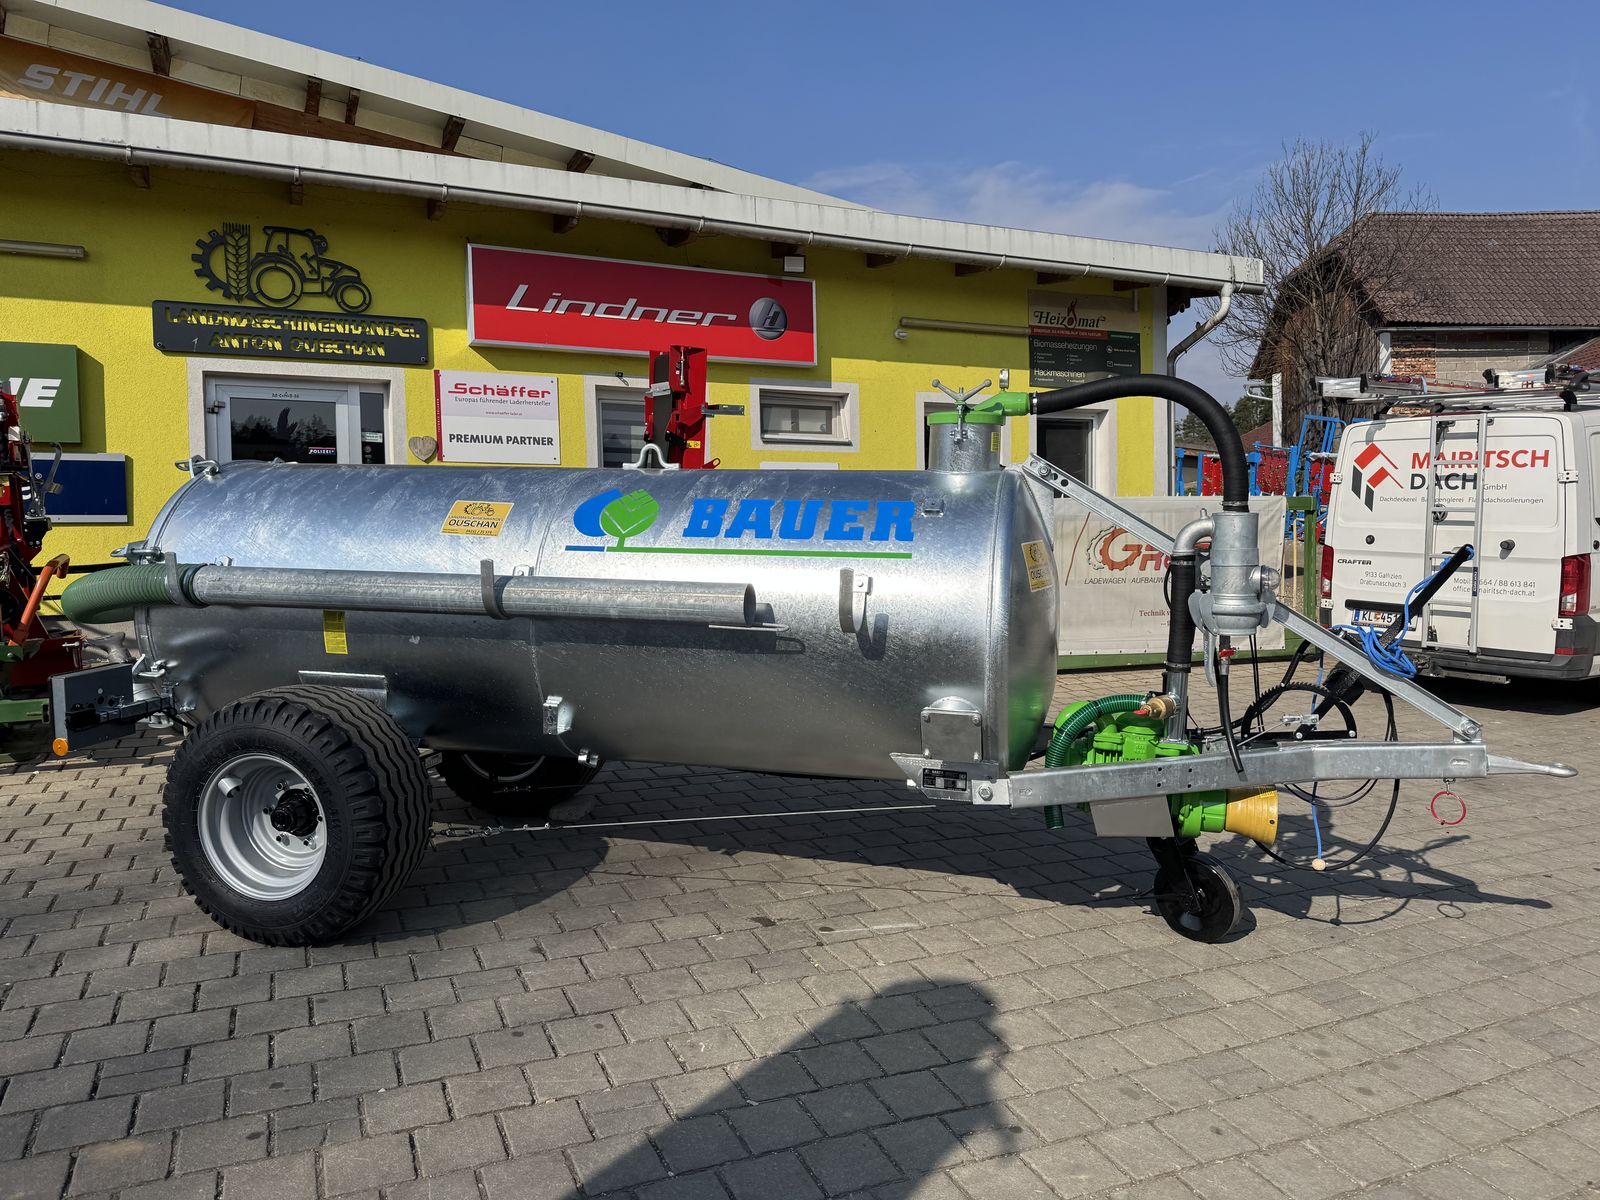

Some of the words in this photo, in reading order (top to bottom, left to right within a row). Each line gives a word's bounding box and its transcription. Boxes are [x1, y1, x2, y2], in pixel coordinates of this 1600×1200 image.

[17, 64, 174, 118] STIHL
[505, 284, 737, 326] Lindner
[164, 306, 421, 338] LANDMASCHINENHANDEL
[209, 332, 283, 351] ANTON
[290, 336, 385, 357] OUSCHAN
[1034, 339, 1098, 352] Biomasseheizungen
[1034, 368, 1086, 378] Hackmaschinen
[448, 383, 551, 399] Schäffer
[480, 397, 509, 405] führender
[510, 398, 551, 407] Laderhersteller
[449, 434, 503, 444] PREMIUM
[506, 436, 554, 446] PARTNER
[448, 519, 499, 529] OUSCHAN
[682, 498, 915, 541] BAUER
[1084, 577, 1127, 585] LADEWAGEN
[1139, 609, 1166, 617] Technik
[1362, 611, 1372, 621] KL
